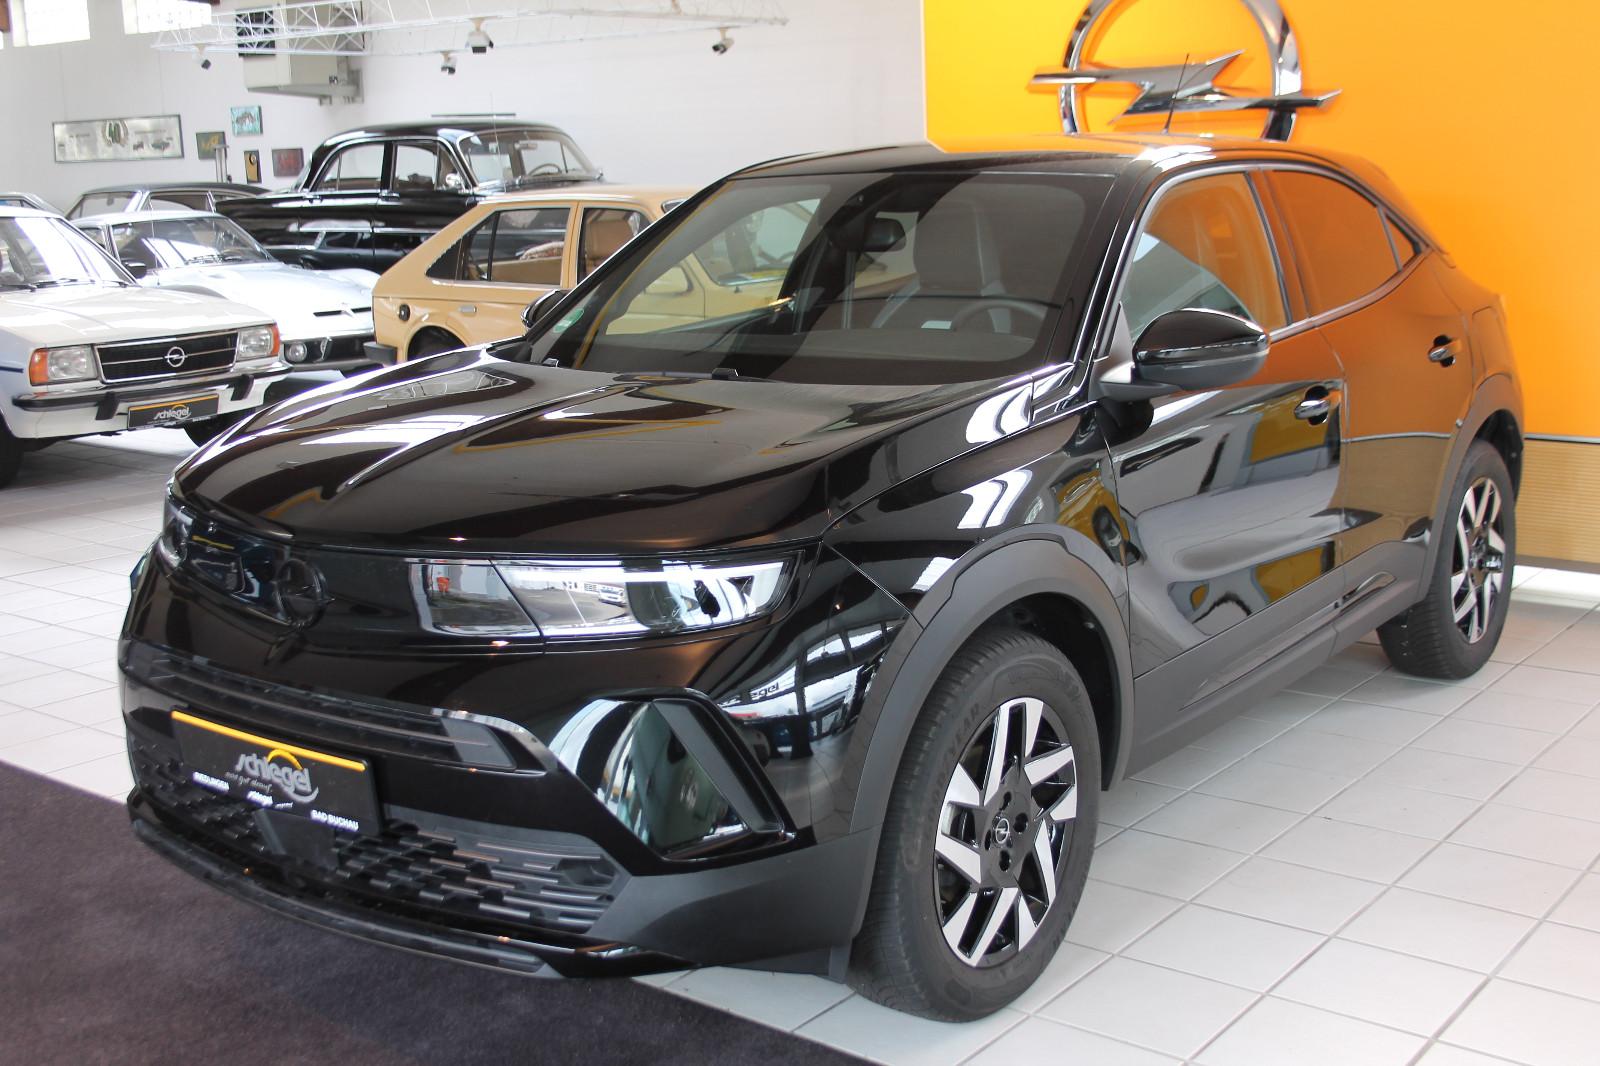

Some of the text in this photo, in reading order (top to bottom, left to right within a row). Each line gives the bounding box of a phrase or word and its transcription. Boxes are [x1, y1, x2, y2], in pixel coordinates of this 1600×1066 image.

[235, 753, 319, 804] schlegel
[310, 809, 359, 832] BAD BUCHAU
